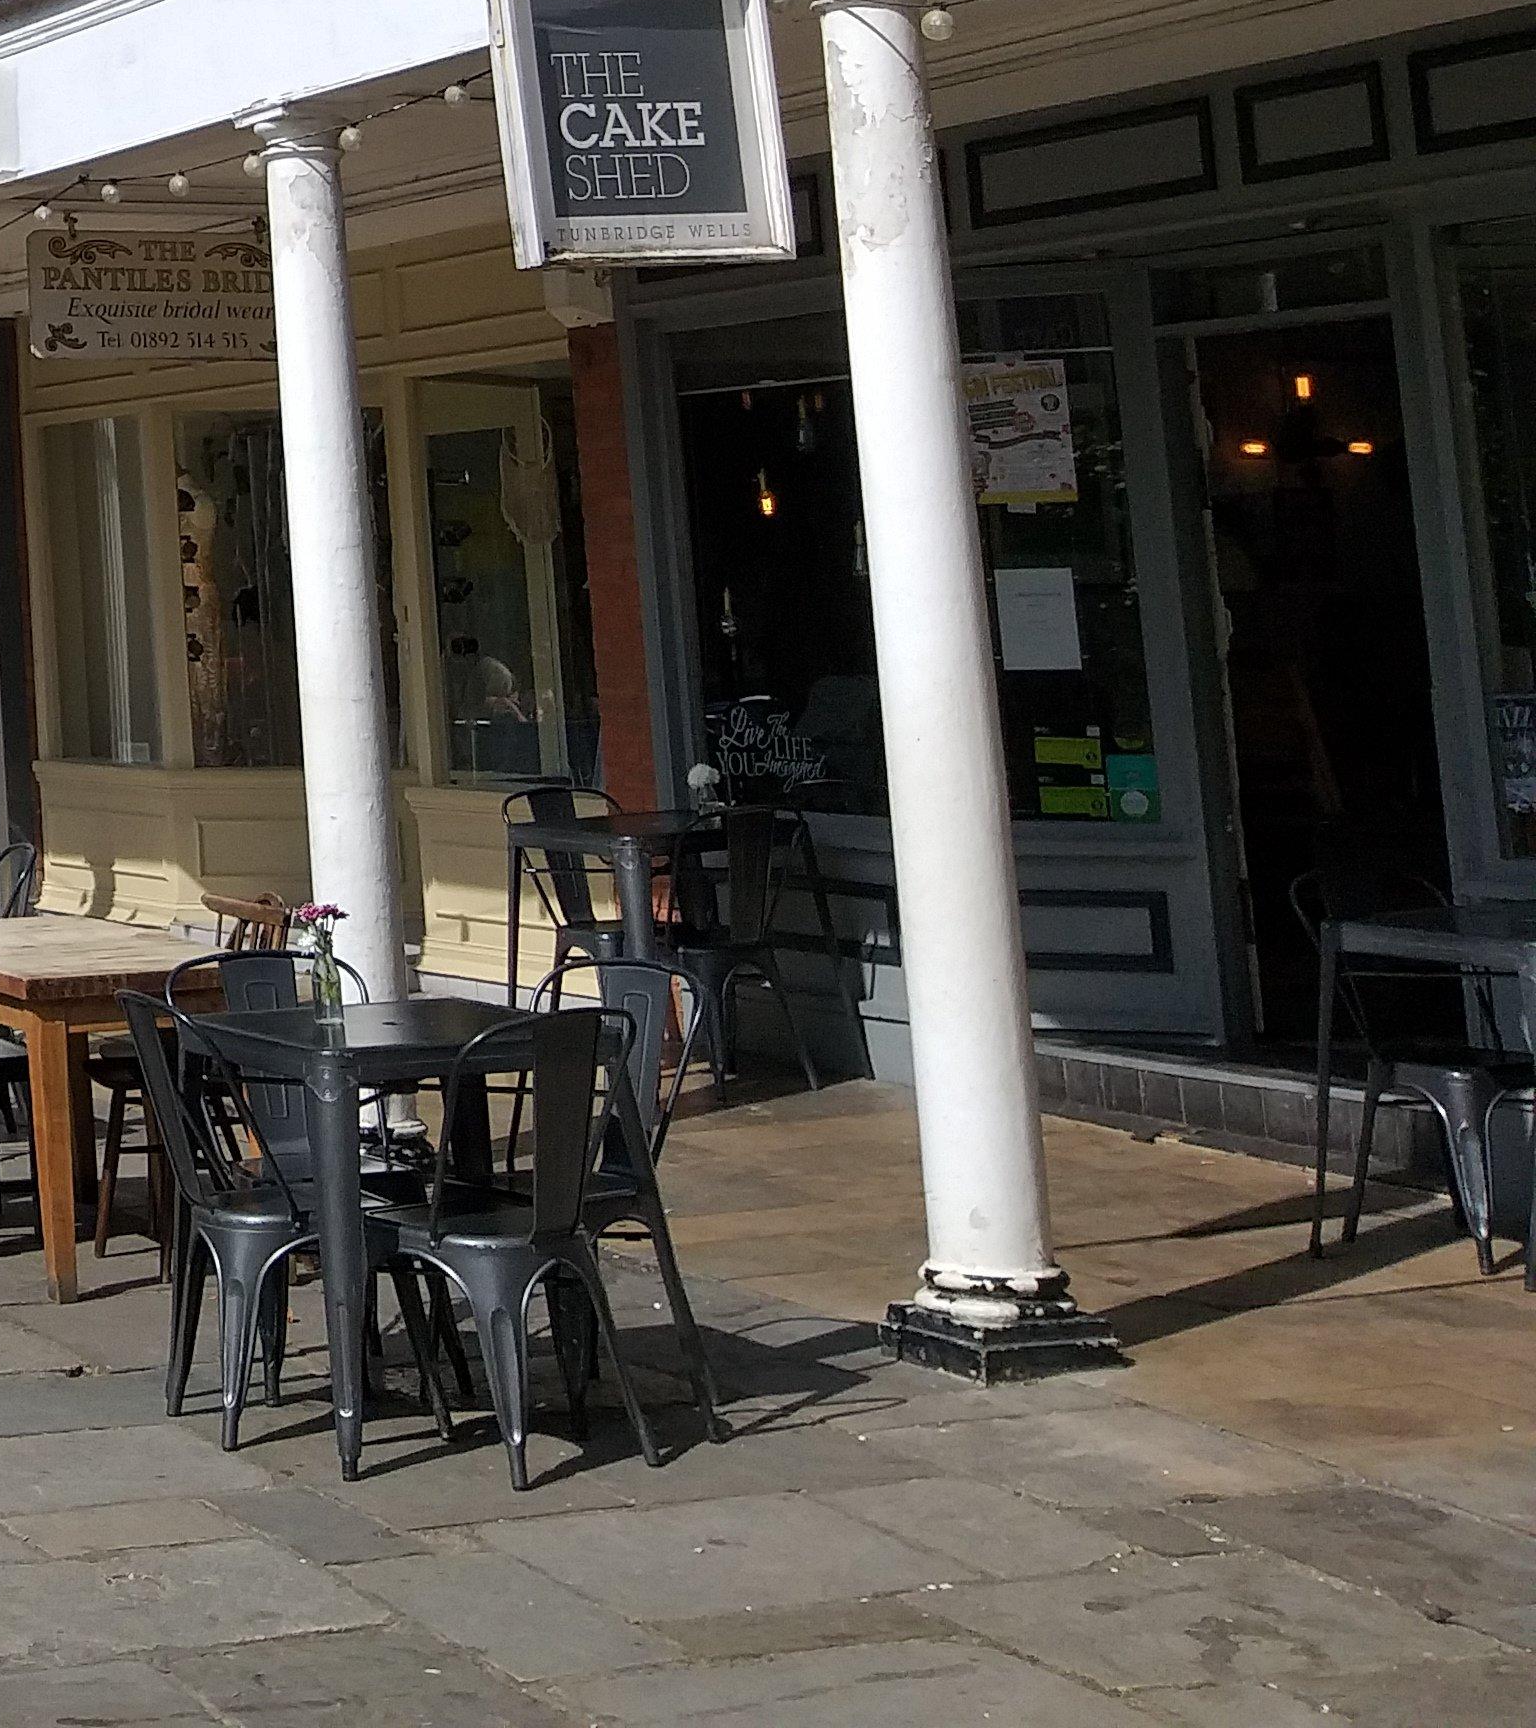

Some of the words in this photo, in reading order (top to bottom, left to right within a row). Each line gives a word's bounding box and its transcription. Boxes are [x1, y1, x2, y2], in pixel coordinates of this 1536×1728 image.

[550, 52, 645, 99] THE
[560, 102, 706, 150] CAKE
[565, 153, 691, 201] SHED
[557, 225, 676, 242] TUNBRIDGE
[689, 223, 753, 238] WELLS
[138, 240, 197, 262] THE
[41, 266, 193, 293] PANTILES
[201, 268, 273, 294] BRID
[67, 297, 157, 325] Exquisite
[162, 299, 221, 320] bridal
[227, 303, 275, 319] wear
[130, 331, 180, 349] 01892
[186, 331, 216, 349] 514
[221, 332, 249, 349] 515
[718, 706, 771, 749] Live
[774, 735, 814, 760] LIFE
[716, 751, 755, 776] YOU
